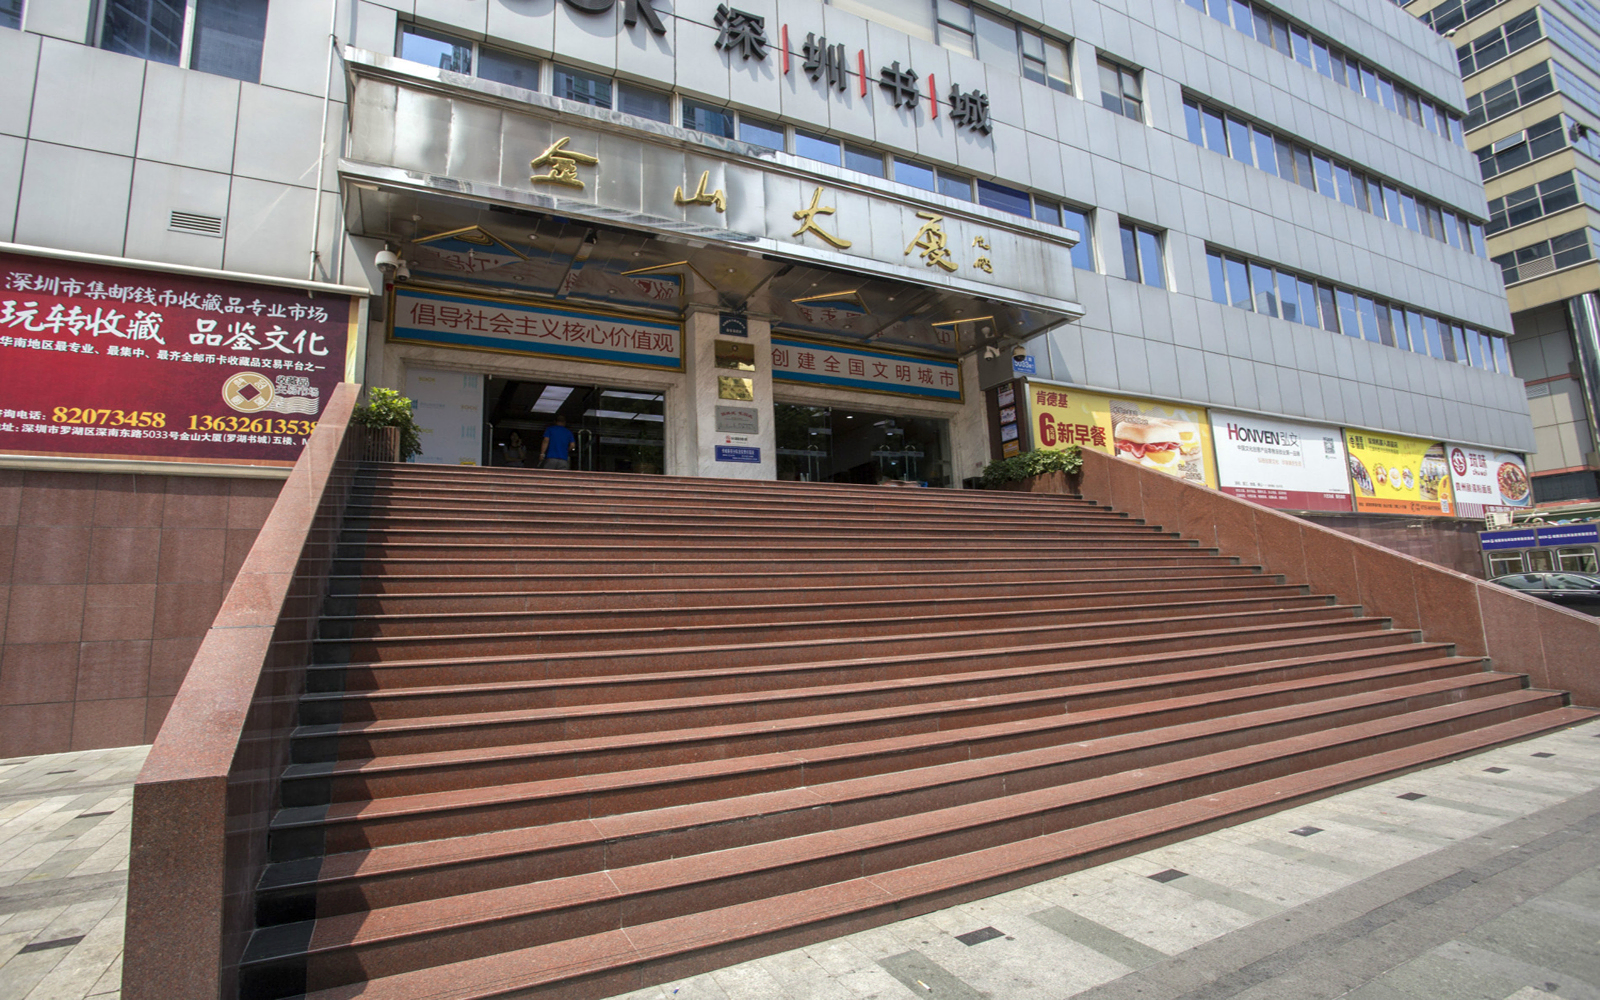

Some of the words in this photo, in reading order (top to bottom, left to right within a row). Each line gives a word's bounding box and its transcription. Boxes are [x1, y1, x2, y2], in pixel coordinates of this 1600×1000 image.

[714, 2, 992, 136] 深圳书城
[530, 135, 959, 272] 金山大厦
[5, 271, 328, 322] 深圳市集邮钱币收藏品专业市场
[0, 300, 165, 345] 玩转收藏
[189, 318, 329, 356] 品鉴文化
[410, 302, 674, 353] 倡导社会主义核心价值观
[772, 347, 954, 387] 创建全国文明城市
[0, 409, 46, 421] 询电话：
[52, 406, 166, 427] 82073458
[188, 415, 319, 436] 13632613538
[1036, 391, 1068, 408] 肯德基
[1039, 412, 1056, 447] 6
[1057, 422, 1107, 447] 新早餐
[1227, 422, 1280, 445] HONVEN
[1280, 432, 1299, 447] 弘文
